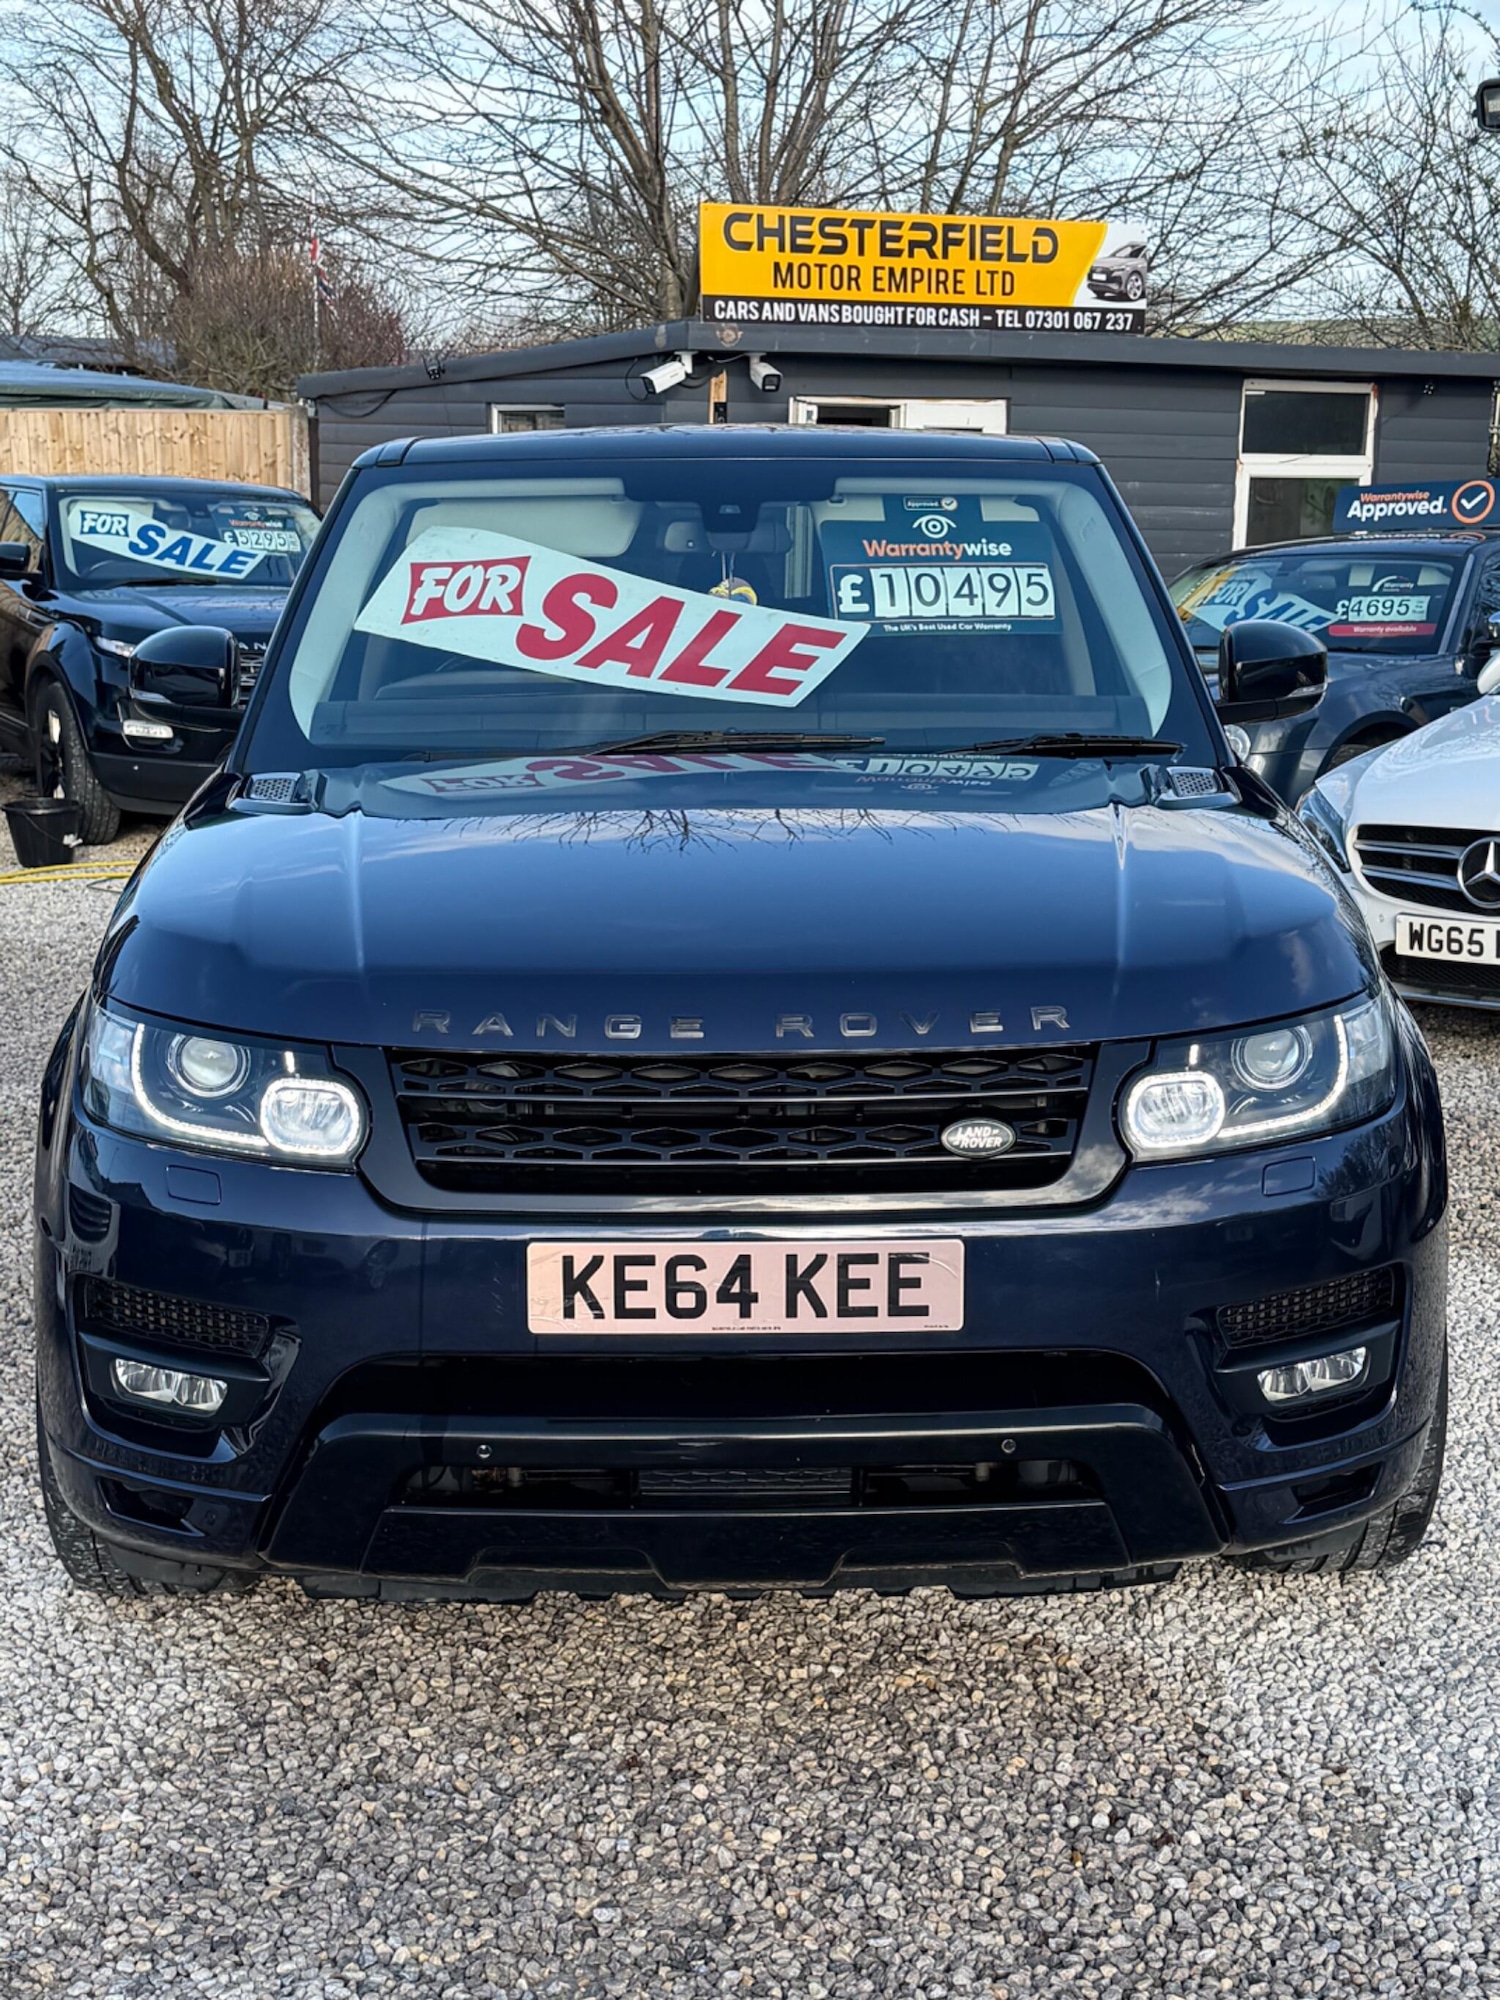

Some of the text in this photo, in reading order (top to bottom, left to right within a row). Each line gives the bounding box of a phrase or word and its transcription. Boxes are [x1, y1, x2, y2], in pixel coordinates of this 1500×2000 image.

[722, 212, 1060, 264] CHESTERFIELD
[773, 262, 1015, 297] MOTOR EMPIRE LTD
[714, 300, 760, 320] CARS
[761, 301, 796, 321] AND
[797, 303, 841, 323] VANS
[842, 305, 906, 325] BOUGHT
[906, 307, 938, 327] FOR
[939, 308, 980, 328] CASH
[996, 309, 1025, 328] TEL
[1025, 310, 1070, 329] 07301
[1073, 312, 1101, 330] 067
[1105, 313, 1134, 331] 237
[1347, 496, 1448, 522] Approved.
[1361, 490, 1430, 503] Warrantywise
[82, 513, 128, 535] FOR
[128, 524, 258, 575] SALE
[863, 538, 1013, 560] Warrantywise
[837, 573, 1050, 613] £10495
[410, 564, 848, 696] FOR SALE
[1384, 625, 1417, 633] available
[1408, 922, 1485, 957] WG65
[412, 1005, 1072, 1040] RANGE ROVER
[957, 1126, 992, 1138] LAND
[959, 1136, 1003, 1149] ROVER
[561, 1251, 930, 1319] KE64 KEE
